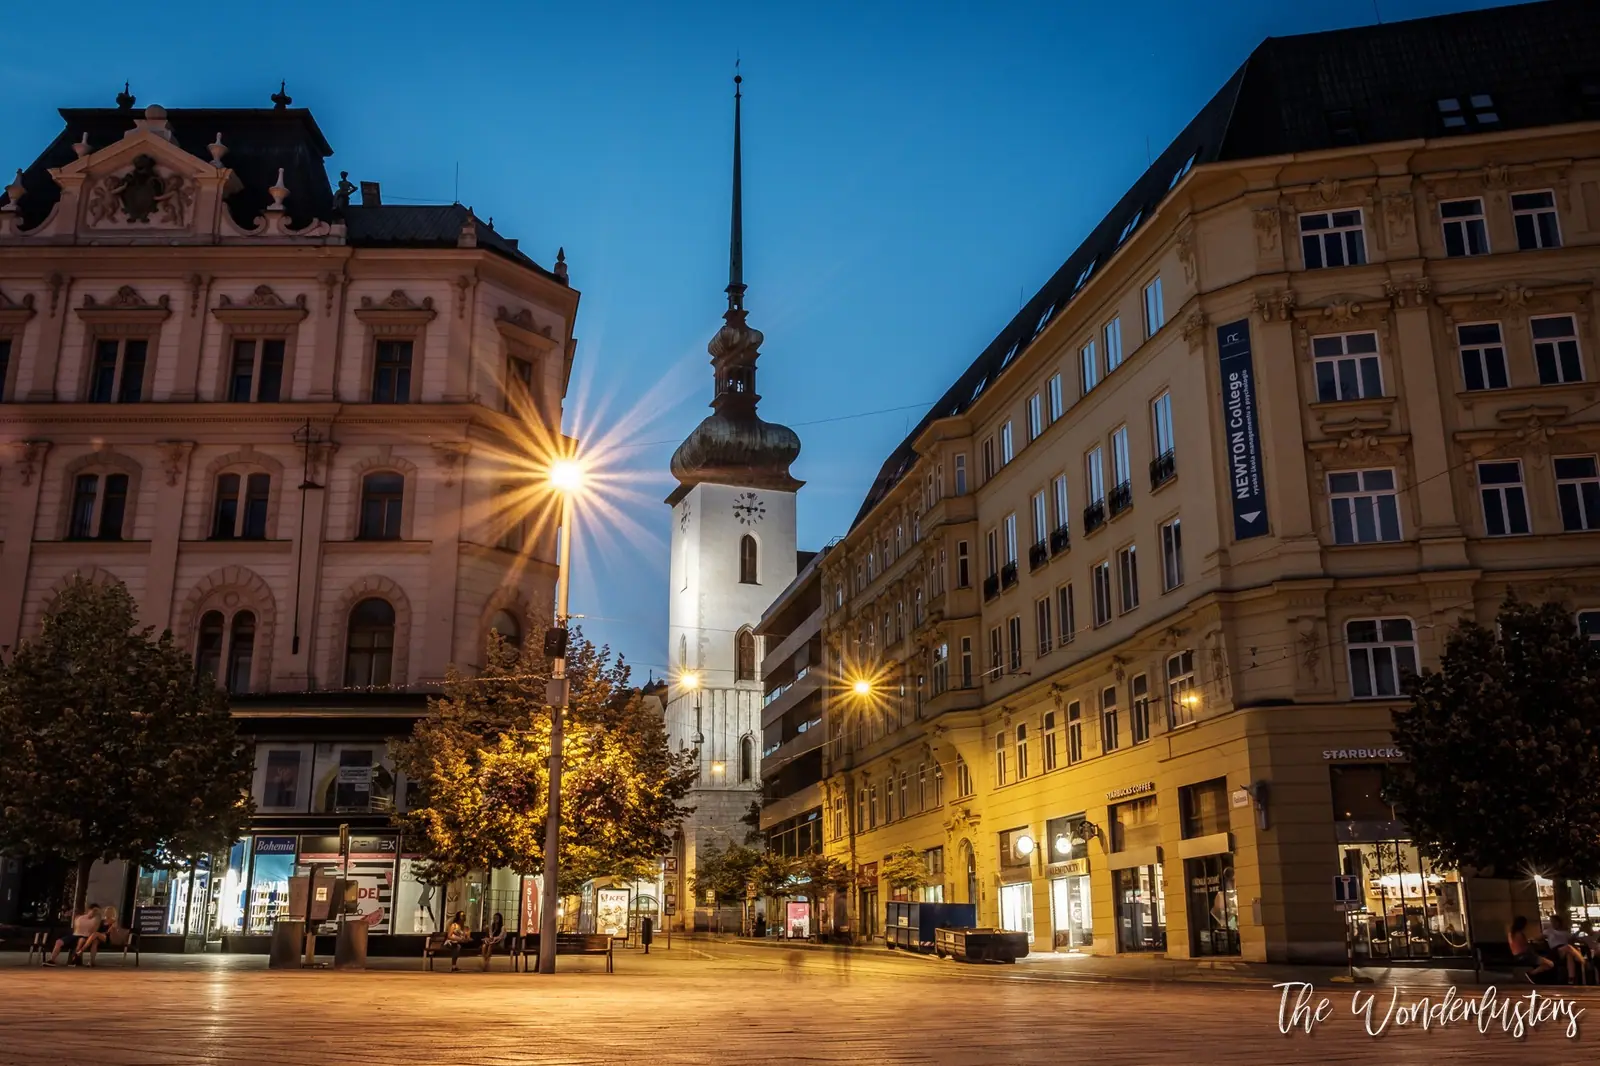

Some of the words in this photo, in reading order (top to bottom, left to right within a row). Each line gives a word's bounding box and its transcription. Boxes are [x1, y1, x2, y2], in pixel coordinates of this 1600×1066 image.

[1228, 372, 1243, 428] College
[1231, 432, 1250, 499] NEWTON
[1322, 748, 1403, 759] STARBUCKS
[1106, 787, 1132, 799] STARBUCKS
[1132, 782, 1151, 793] COFFEE
[257, 840, 294, 851] Bohemia
